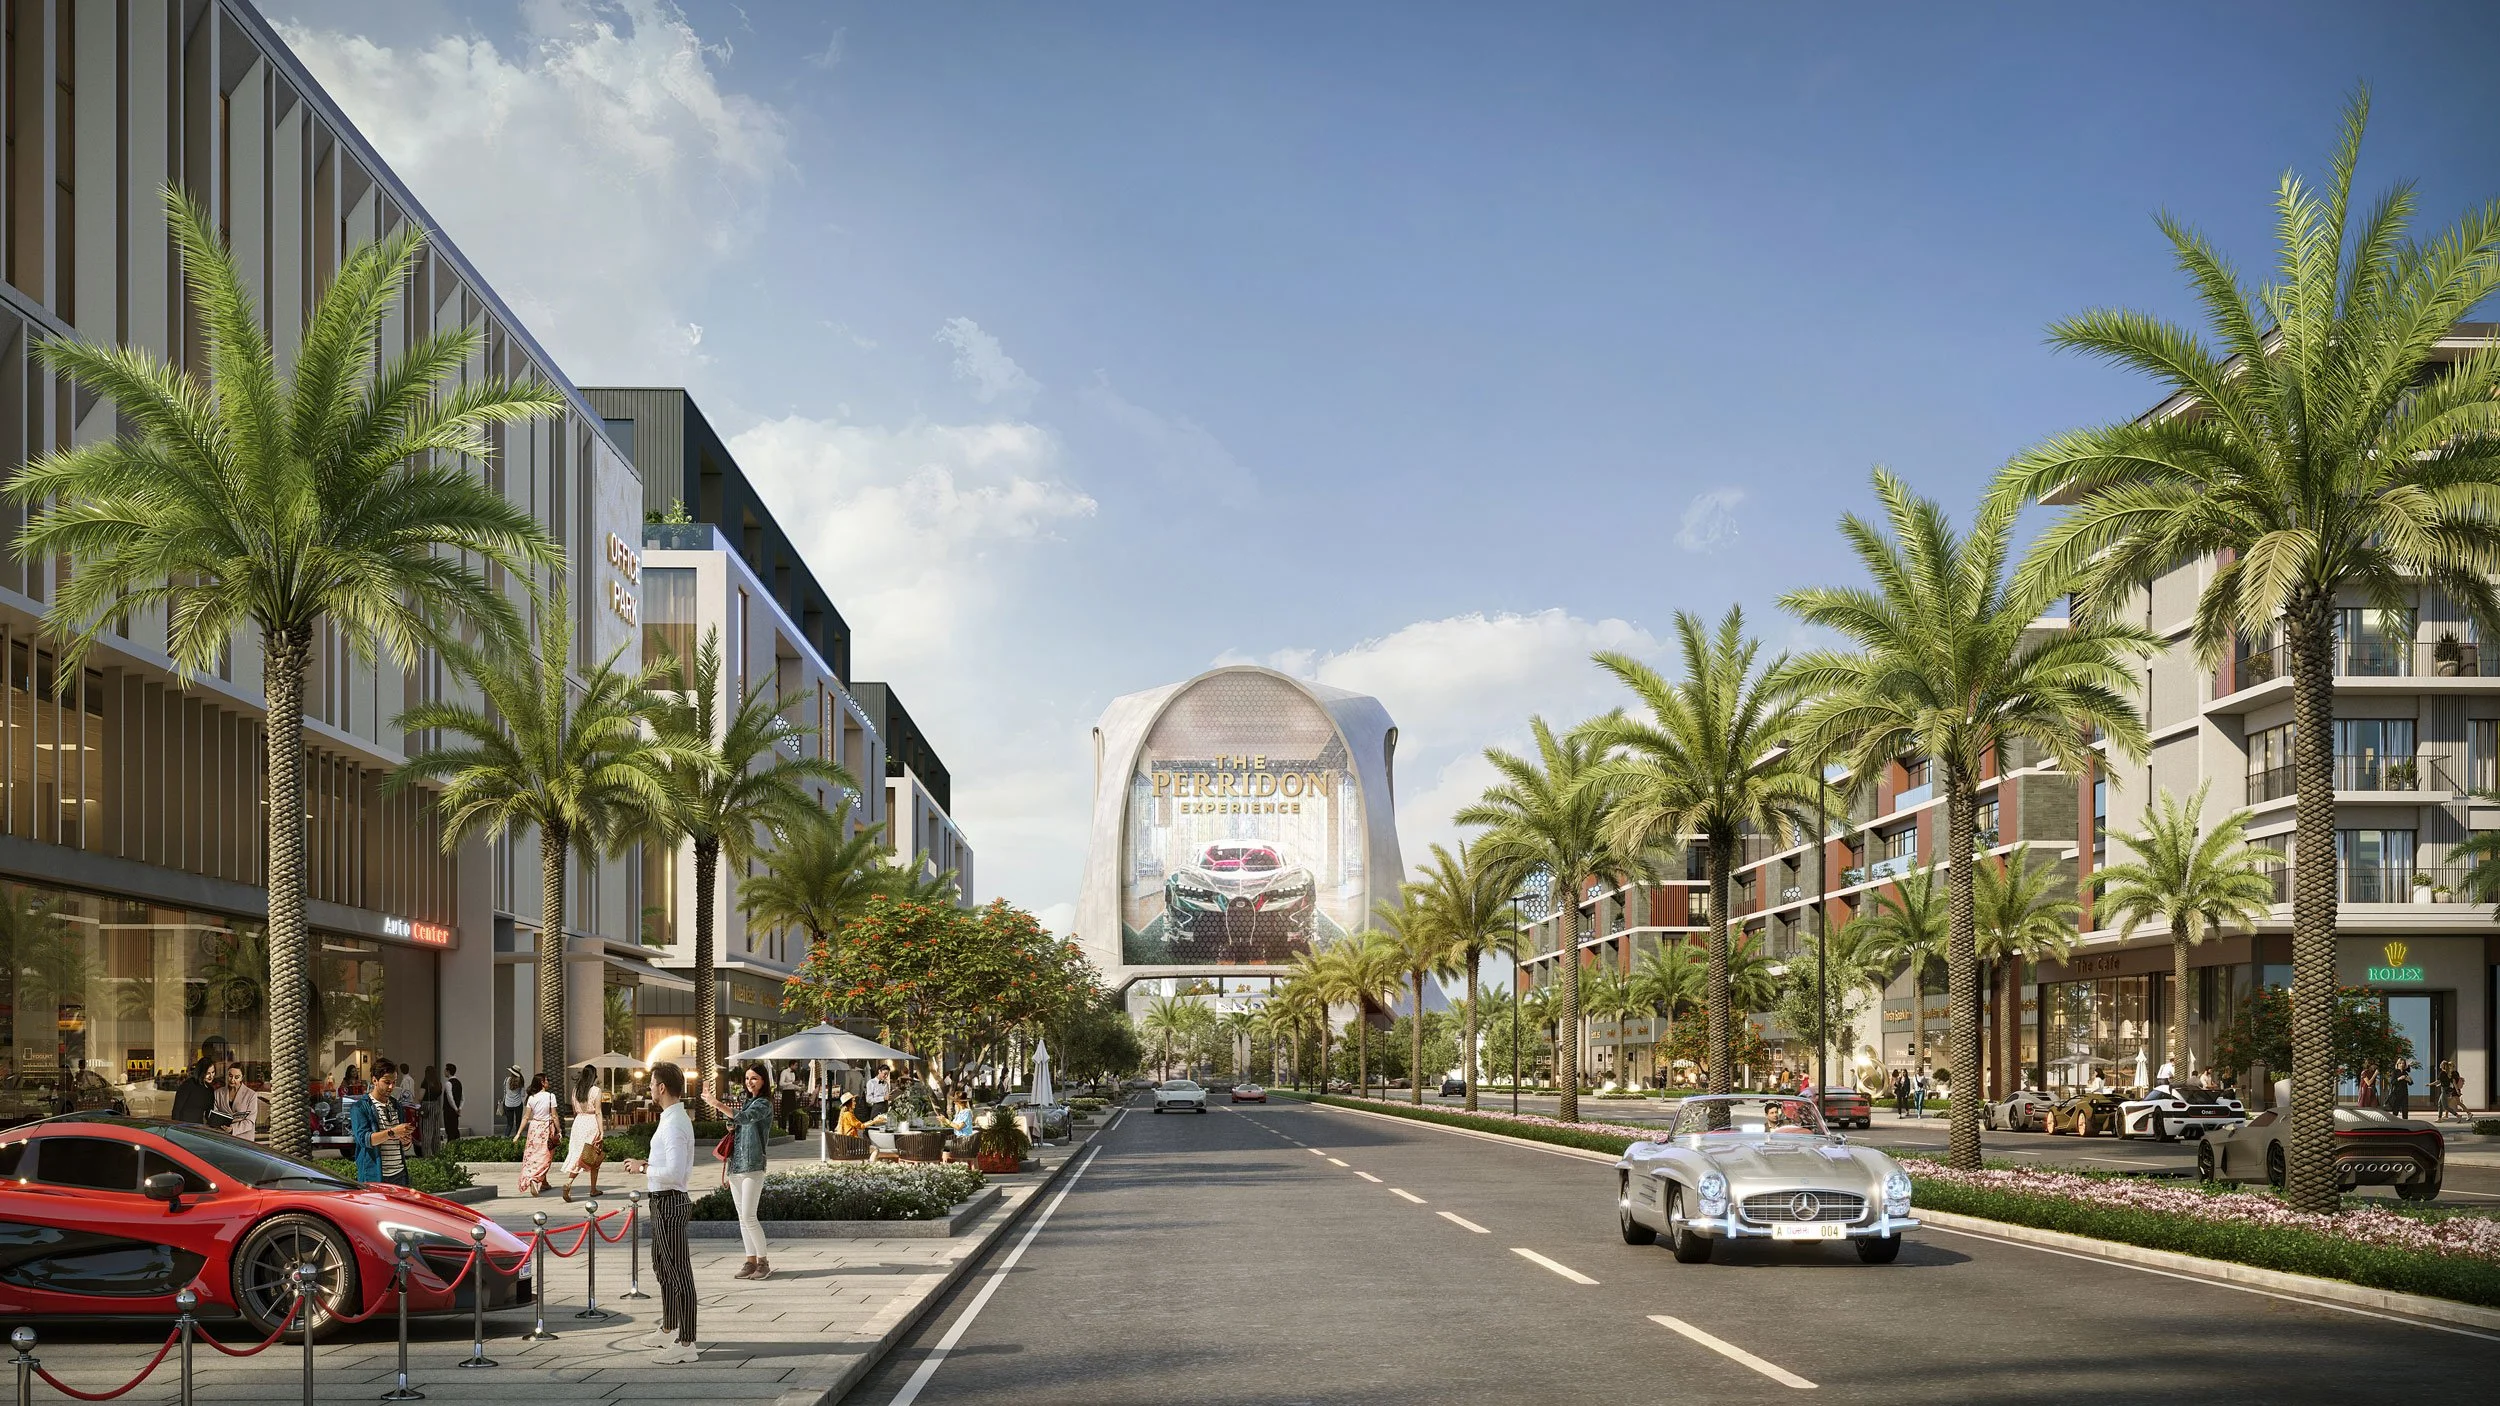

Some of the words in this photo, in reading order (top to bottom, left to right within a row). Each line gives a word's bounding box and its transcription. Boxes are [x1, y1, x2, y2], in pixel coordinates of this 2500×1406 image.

[609, 532, 641, 585] OFFICE
[612, 580, 638, 627] PARK
[1214, 754, 1267, 770] THE
[1152, 772, 1330, 797] PERRIDON
[1180, 803, 1301, 814] EXPERIENCE
[384, 917, 410, 937] Auto
[413, 922, 449, 944] Center
[2075, 960, 2093, 973] The
[2368, 968, 2424, 981] ROLEX
[1776, 1226, 1783, 1237] A
[1821, 1225, 1839, 1237] 004
